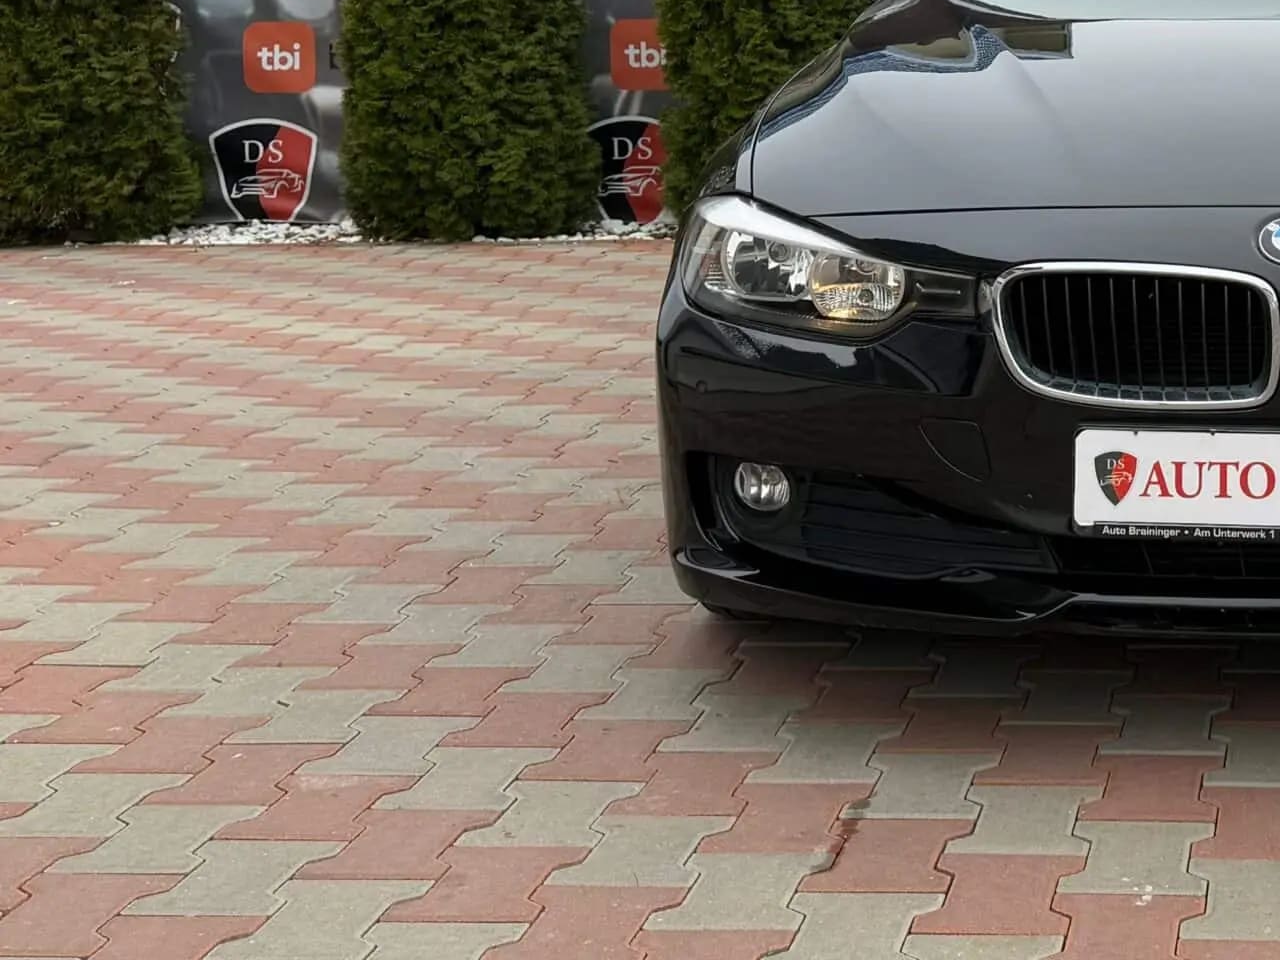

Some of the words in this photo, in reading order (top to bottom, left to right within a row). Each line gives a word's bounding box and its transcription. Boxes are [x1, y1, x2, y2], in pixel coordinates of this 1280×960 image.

[256, 42, 301, 71] tbi
[242, 139, 284, 164] DS
[611, 136, 653, 160] DS
[1106, 458, 1125, 470] DS
[1139, 460, 1276, 500] AUTO
[1102, 525, 1126, 536] Auto
[1193, 527, 1211, 537] Am
[1213, 527, 1266, 539] Unterwerk
